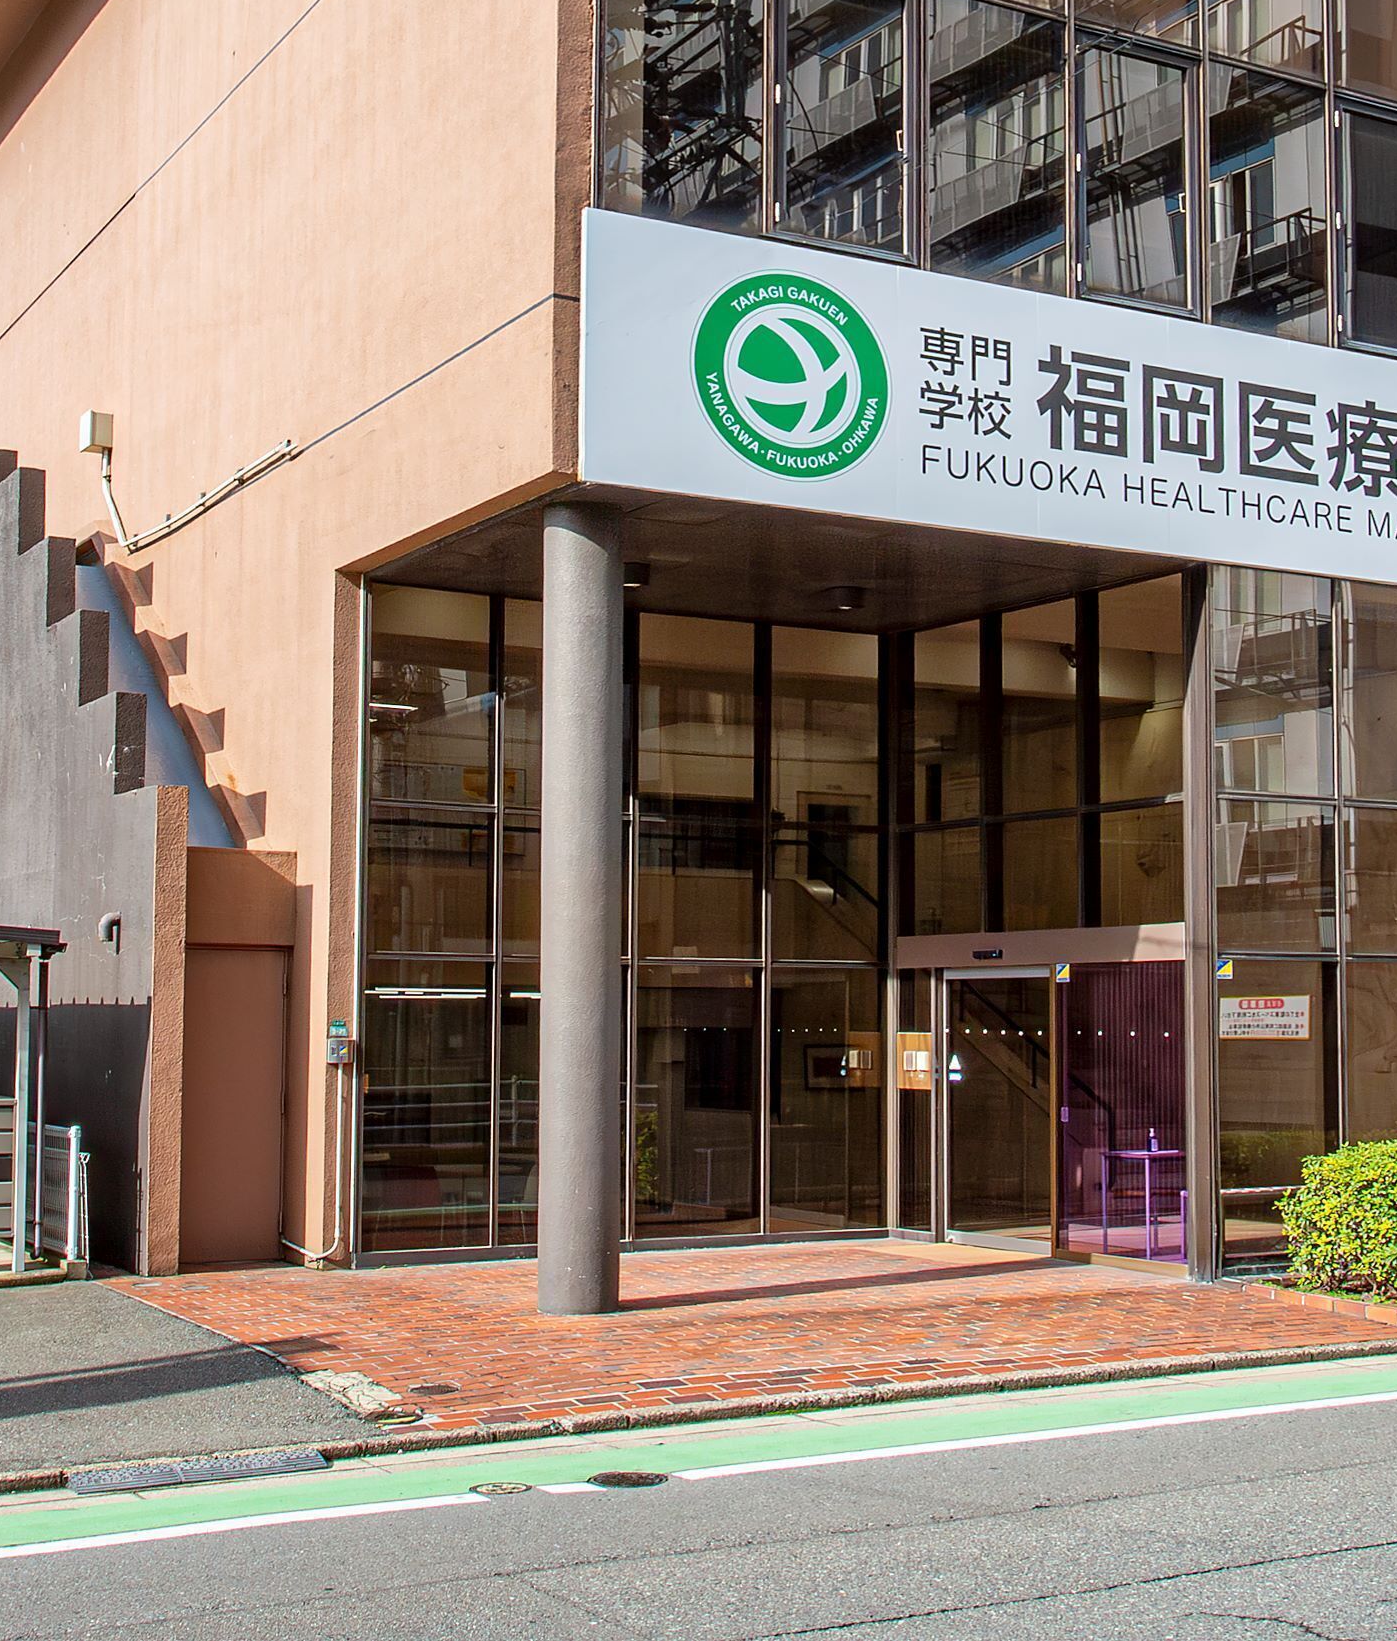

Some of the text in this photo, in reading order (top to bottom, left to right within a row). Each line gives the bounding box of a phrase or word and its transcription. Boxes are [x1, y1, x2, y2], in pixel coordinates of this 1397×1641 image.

[730, 285, 849, 326] TAKAGI GAKUEN
[919, 327, 1013, 387] 専門
[918, 380, 1013, 440] 学校
[921, 444, 1106, 500] FUKUOKA
[1123, 472, 1354, 535] HEALTHCARE
